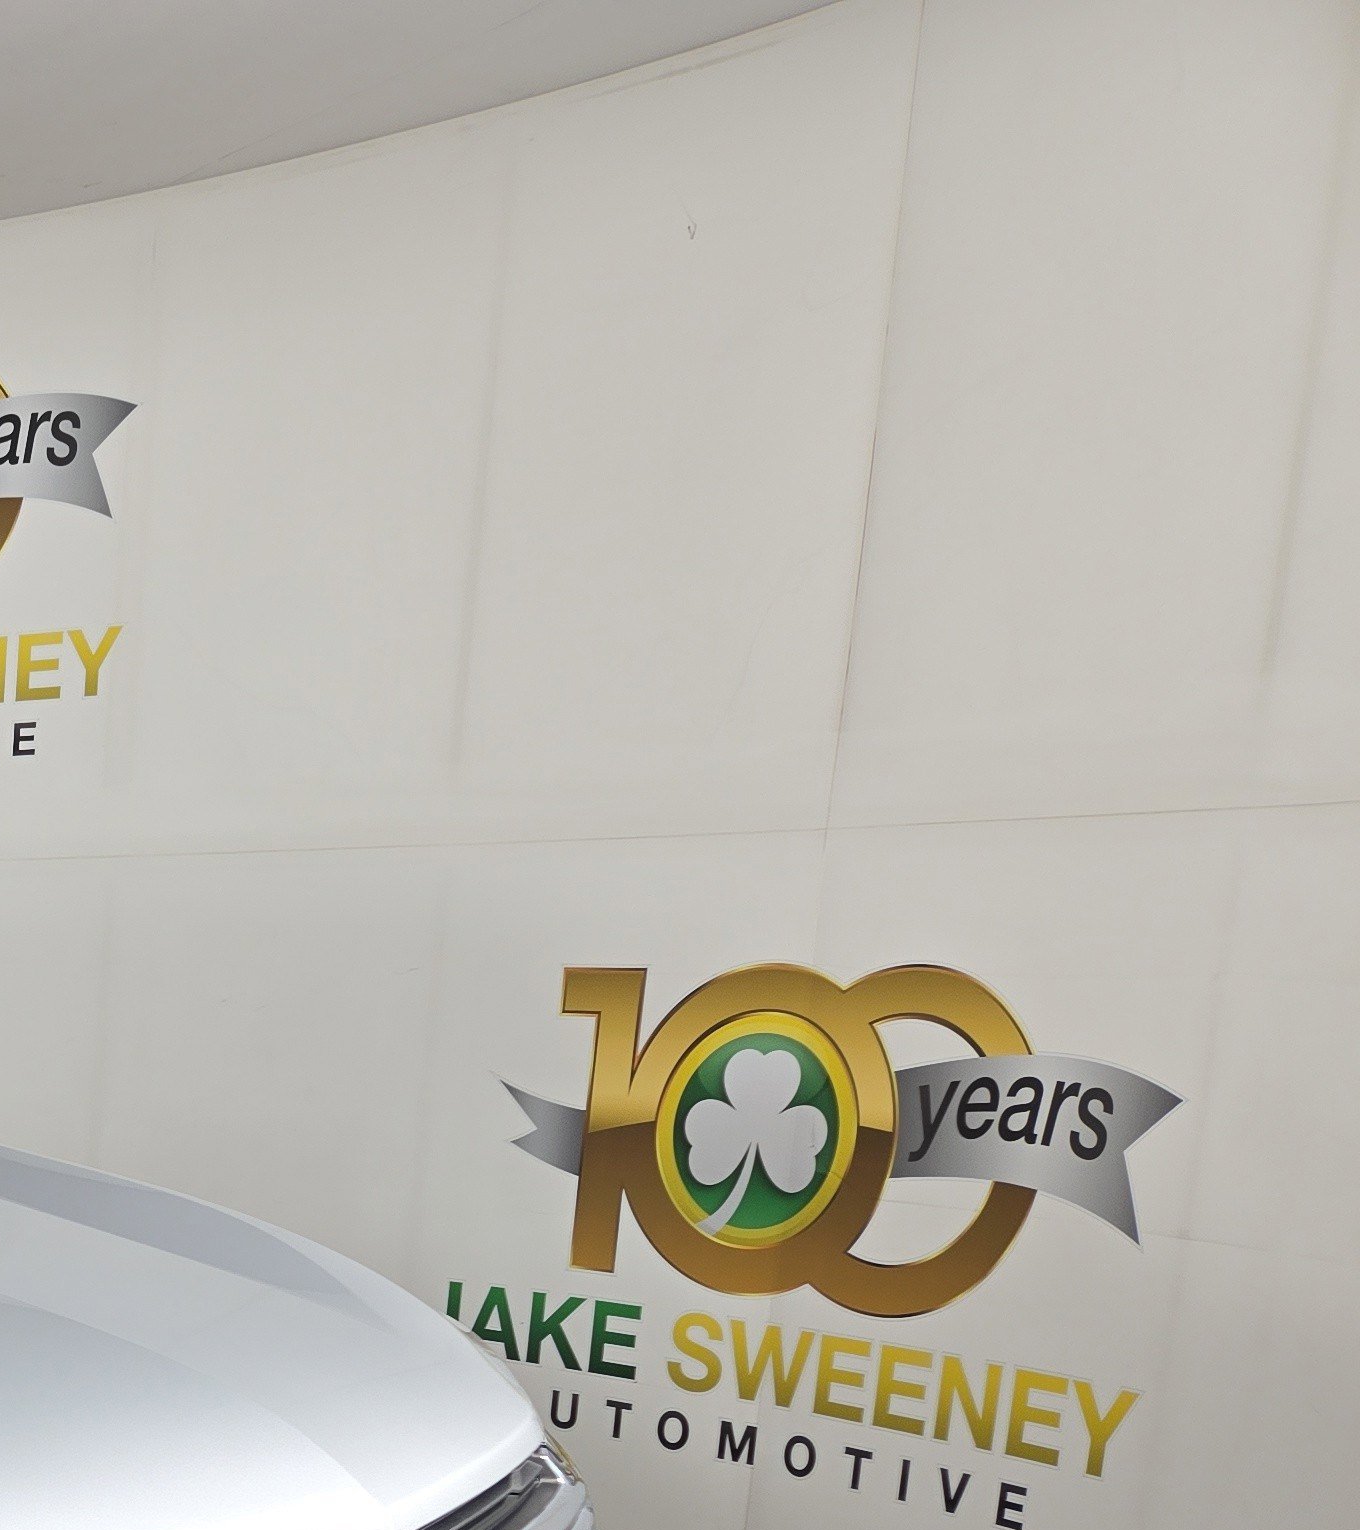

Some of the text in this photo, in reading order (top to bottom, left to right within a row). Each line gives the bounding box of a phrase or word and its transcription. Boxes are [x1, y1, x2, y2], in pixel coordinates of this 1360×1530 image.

[560, 963, 1114, 1318] 100 years
[550, 1390, 1028, 1530] UTOMOTIVE
[667, 1313, 1141, 1477] SWEENEY
